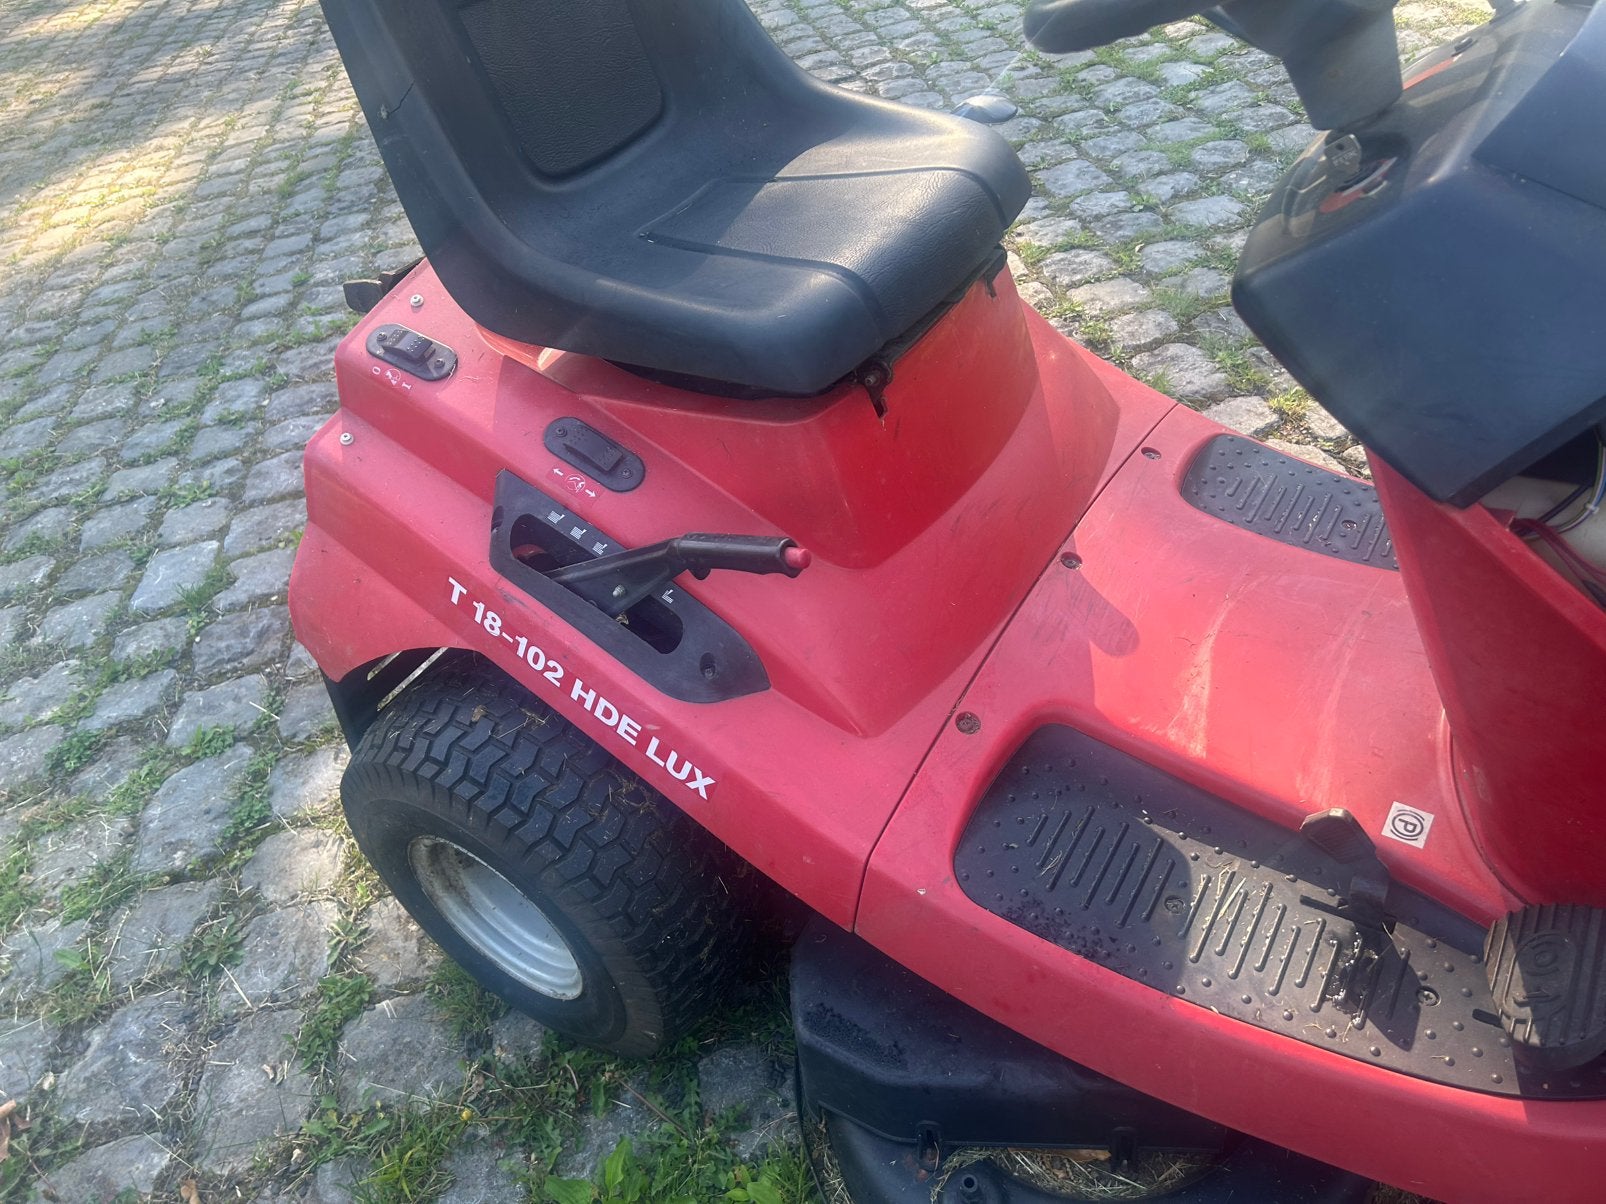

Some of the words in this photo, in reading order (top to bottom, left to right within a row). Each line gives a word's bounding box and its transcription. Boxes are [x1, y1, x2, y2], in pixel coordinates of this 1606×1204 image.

[448, 577, 467, 605] T
[472, 601, 564, 687] 18-102
[570, 678, 642, 746] HDE
[645, 736, 716, 800] LUX
